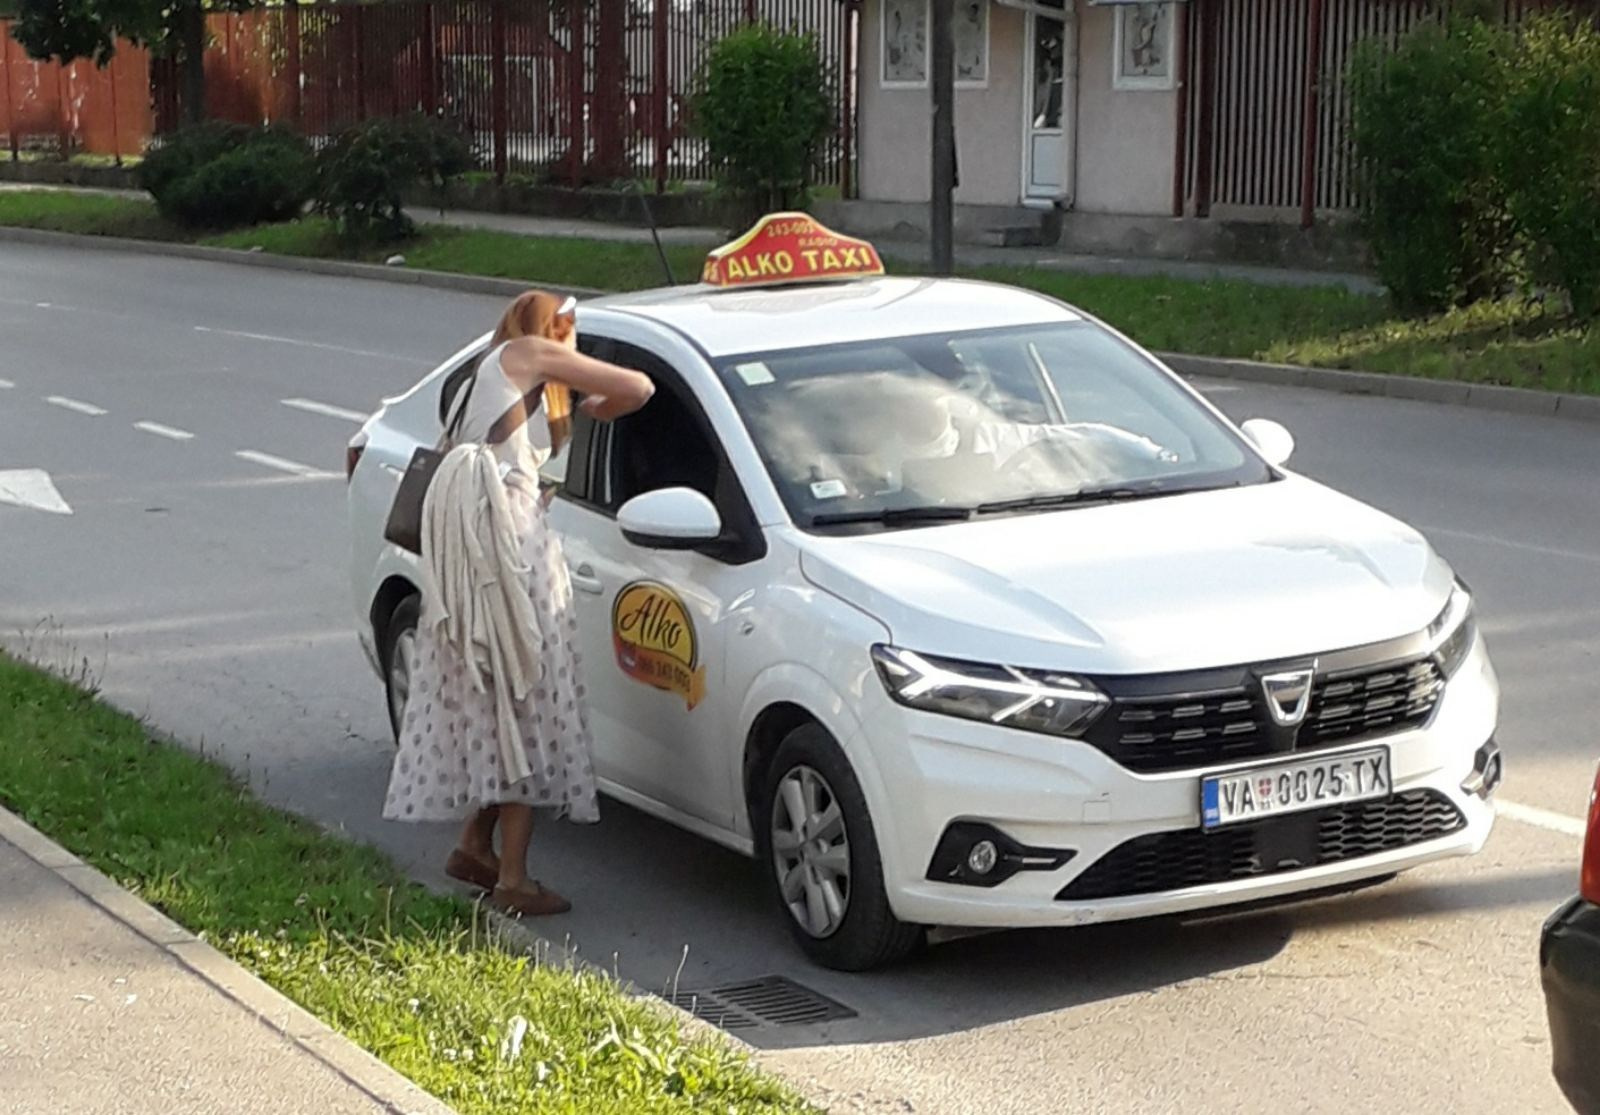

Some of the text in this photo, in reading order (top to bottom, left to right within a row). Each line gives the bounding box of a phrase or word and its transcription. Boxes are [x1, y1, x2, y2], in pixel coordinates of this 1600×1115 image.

[727, 250, 795, 279] ALKO
[801, 246, 872, 271] TAXI
[620, 593, 682, 649] Alko
[1223, 756, 1387, 815] VA 0025 TX
